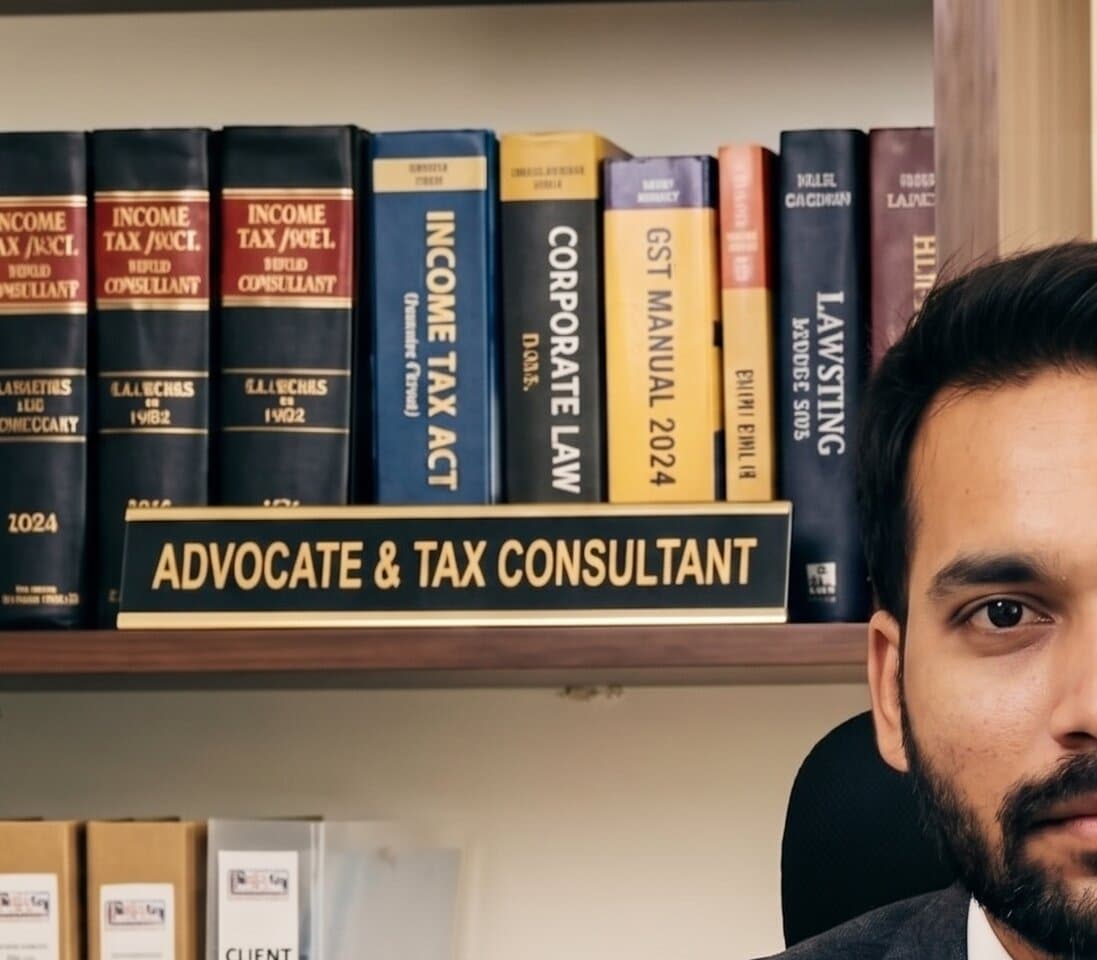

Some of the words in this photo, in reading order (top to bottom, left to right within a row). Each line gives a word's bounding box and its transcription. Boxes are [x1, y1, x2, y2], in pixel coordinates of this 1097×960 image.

[103, 231, 142, 251] TAX
[112, 206, 191, 228] INCOME
[236, 228, 276, 249] TAX
[248, 203, 327, 225] INCOME
[426, 211, 456, 343] INCOME
[646, 227, 671, 279] GST
[548, 226, 580, 416] CORPORATE
[647, 290, 675, 408] MANUAL
[428, 351, 457, 417] TAX
[816, 291, 845, 456] LAWSTING
[428, 425, 458, 491] ACT
[551, 425, 581, 494] LAW
[649, 418, 676, 487] 2024
[152, 541, 363, 590] ADVOCATE
[374, 540, 400, 588] &
[413, 541, 487, 588] TAX
[498, 537, 758, 587] CONSULTANT
